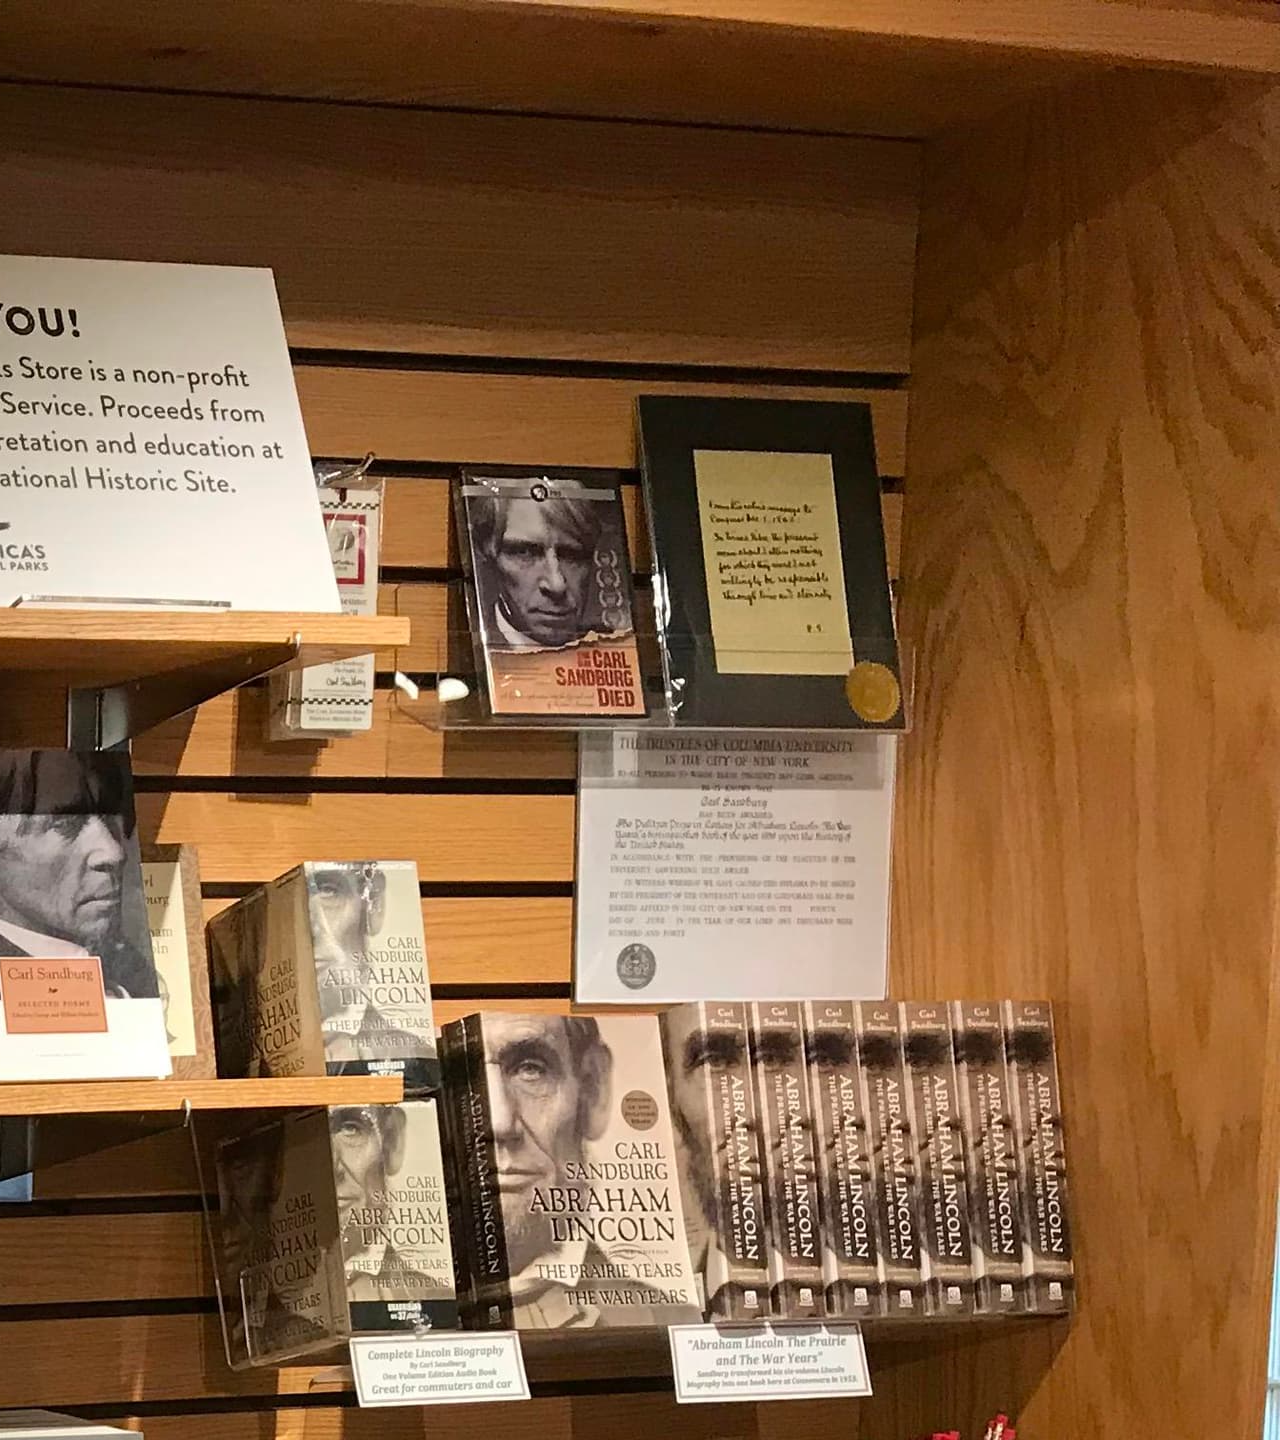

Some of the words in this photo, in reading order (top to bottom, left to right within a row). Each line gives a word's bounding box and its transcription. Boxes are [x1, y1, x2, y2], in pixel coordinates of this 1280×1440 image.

[19, 359, 82, 382] Store
[89, 362, 107, 383] is
[114, 367, 125, 383] a
[132, 362, 249, 391] non-profit
[1, 394, 93, 419] Service.
[101, 396, 204, 422] Proceeds
[210, 399, 264, 424] from
[96, 432, 136, 456] and
[144, 434, 254, 460] education
[262, 438, 283, 460] at
[86, 468, 178, 492] Historic
[186, 469, 236, 494] Site.
[10, 561, 48, 572] PARKS
[593, 650, 631, 669] CARL
[555, 667, 633, 687] SANDBURG
[598, 689, 635, 708] DIED
[7, 968, 34, 980] Carl
[36, 967, 93, 982] Sandburg
[615, 1143, 666, 1159] CARL
[566, 1163, 668, 1180] SANDBURG
[530, 1188, 672, 1213] ABRAHAM
[551, 1217, 675, 1242] LINCOLN
[536, 1264, 567, 1279] THE
[570, 1264, 630, 1278] PRAIRIE
[634, 1263, 682, 1277] YEARS
[565, 1290, 598, 1305] THE
[599, 1290, 635, 1305] WAR
[638, 1290, 688, 1304] YEARS
